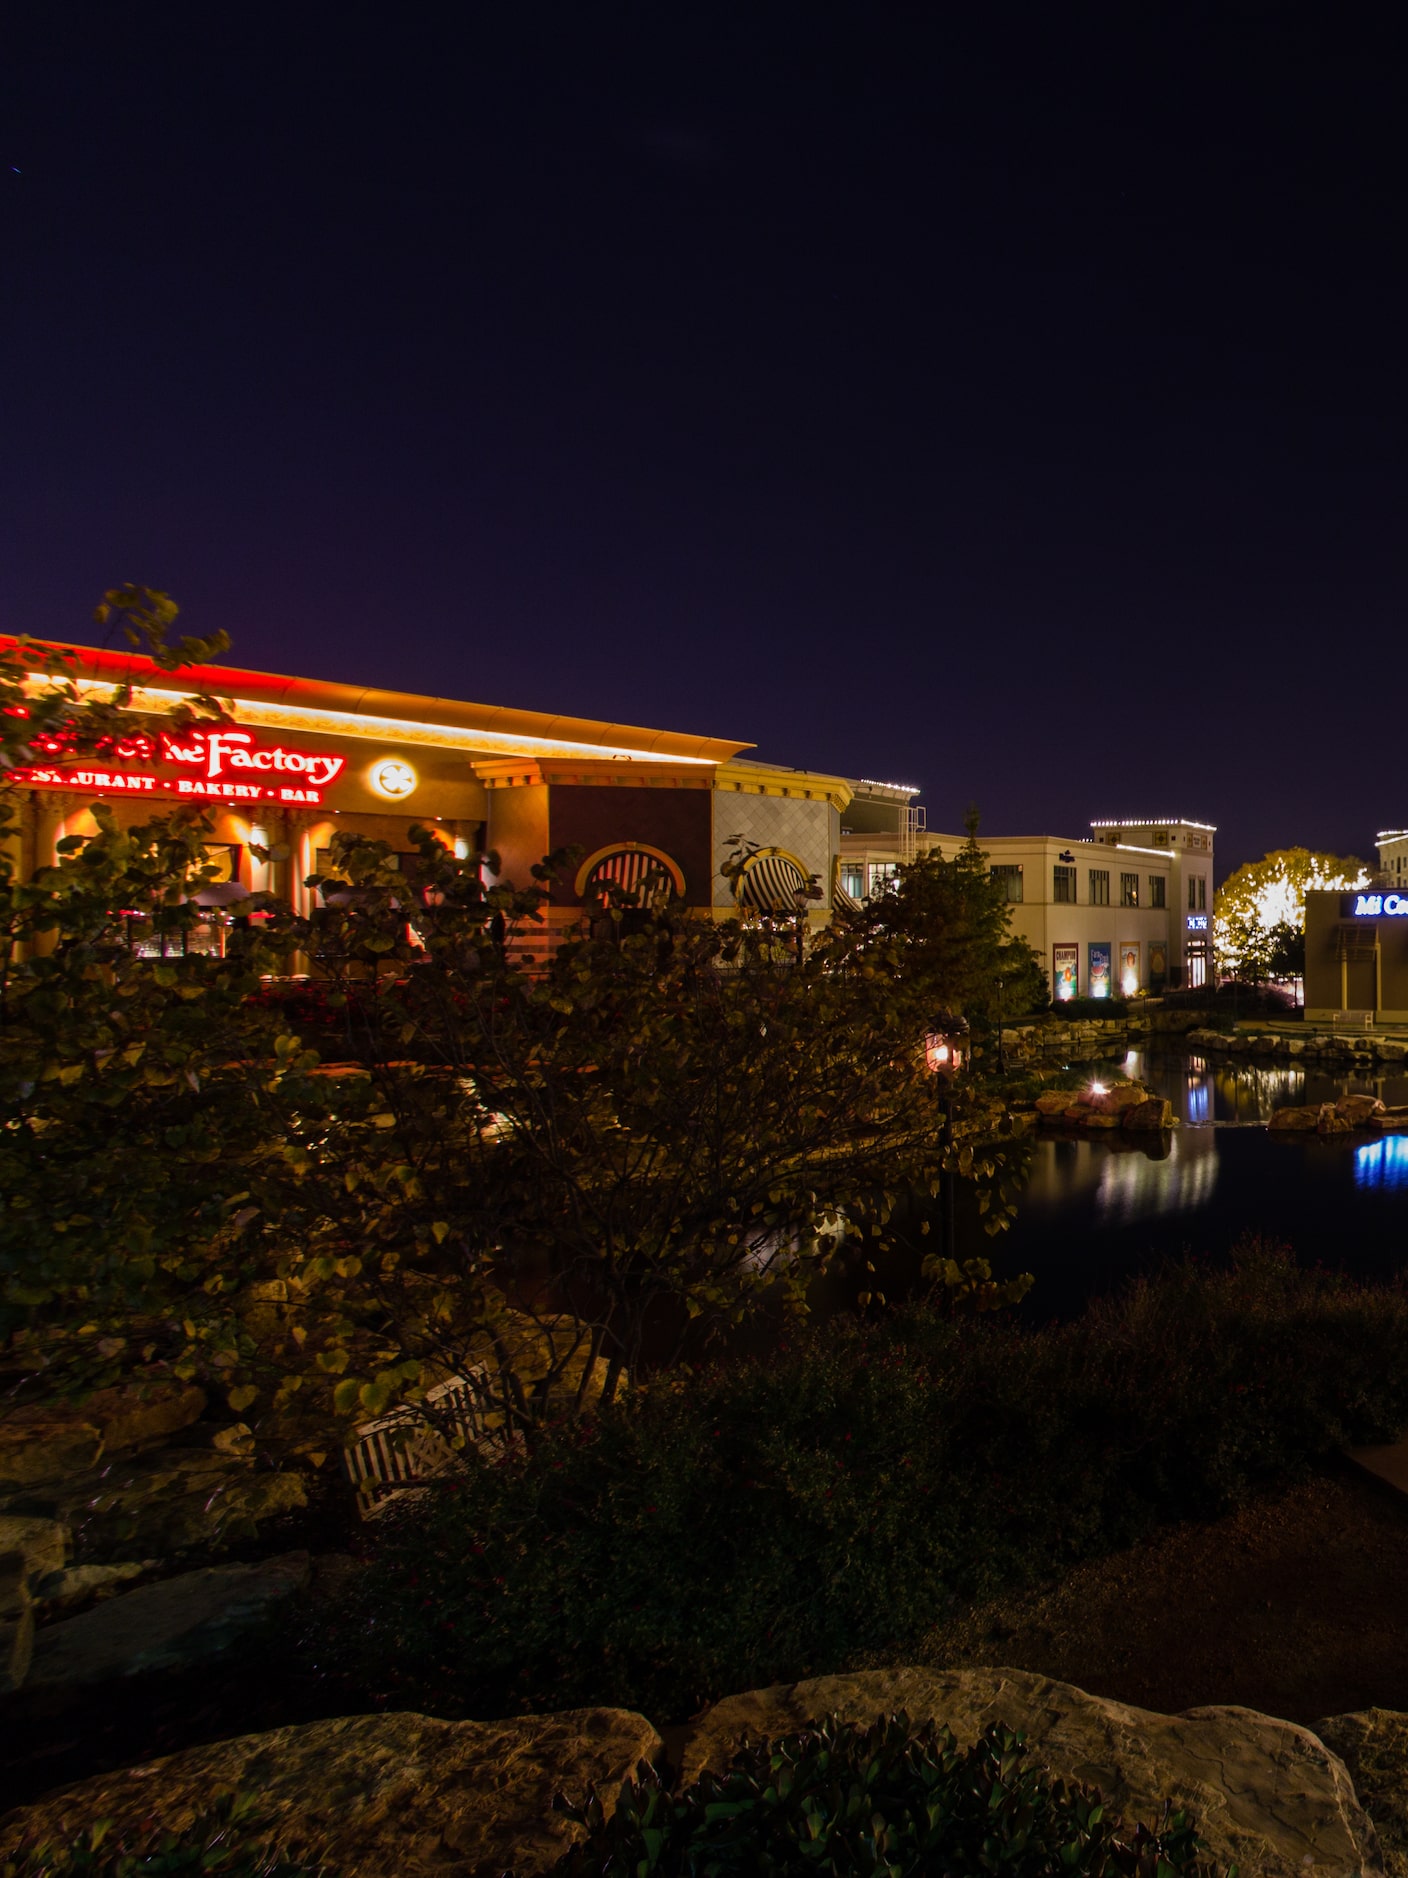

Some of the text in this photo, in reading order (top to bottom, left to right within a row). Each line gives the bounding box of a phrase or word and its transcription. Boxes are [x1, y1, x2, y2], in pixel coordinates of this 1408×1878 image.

[207, 732, 344, 785] Factory
[178, 780, 262, 798] BAKERY
[280, 788, 320, 803] BAR
[1355, 895, 1382, 915] Mi
